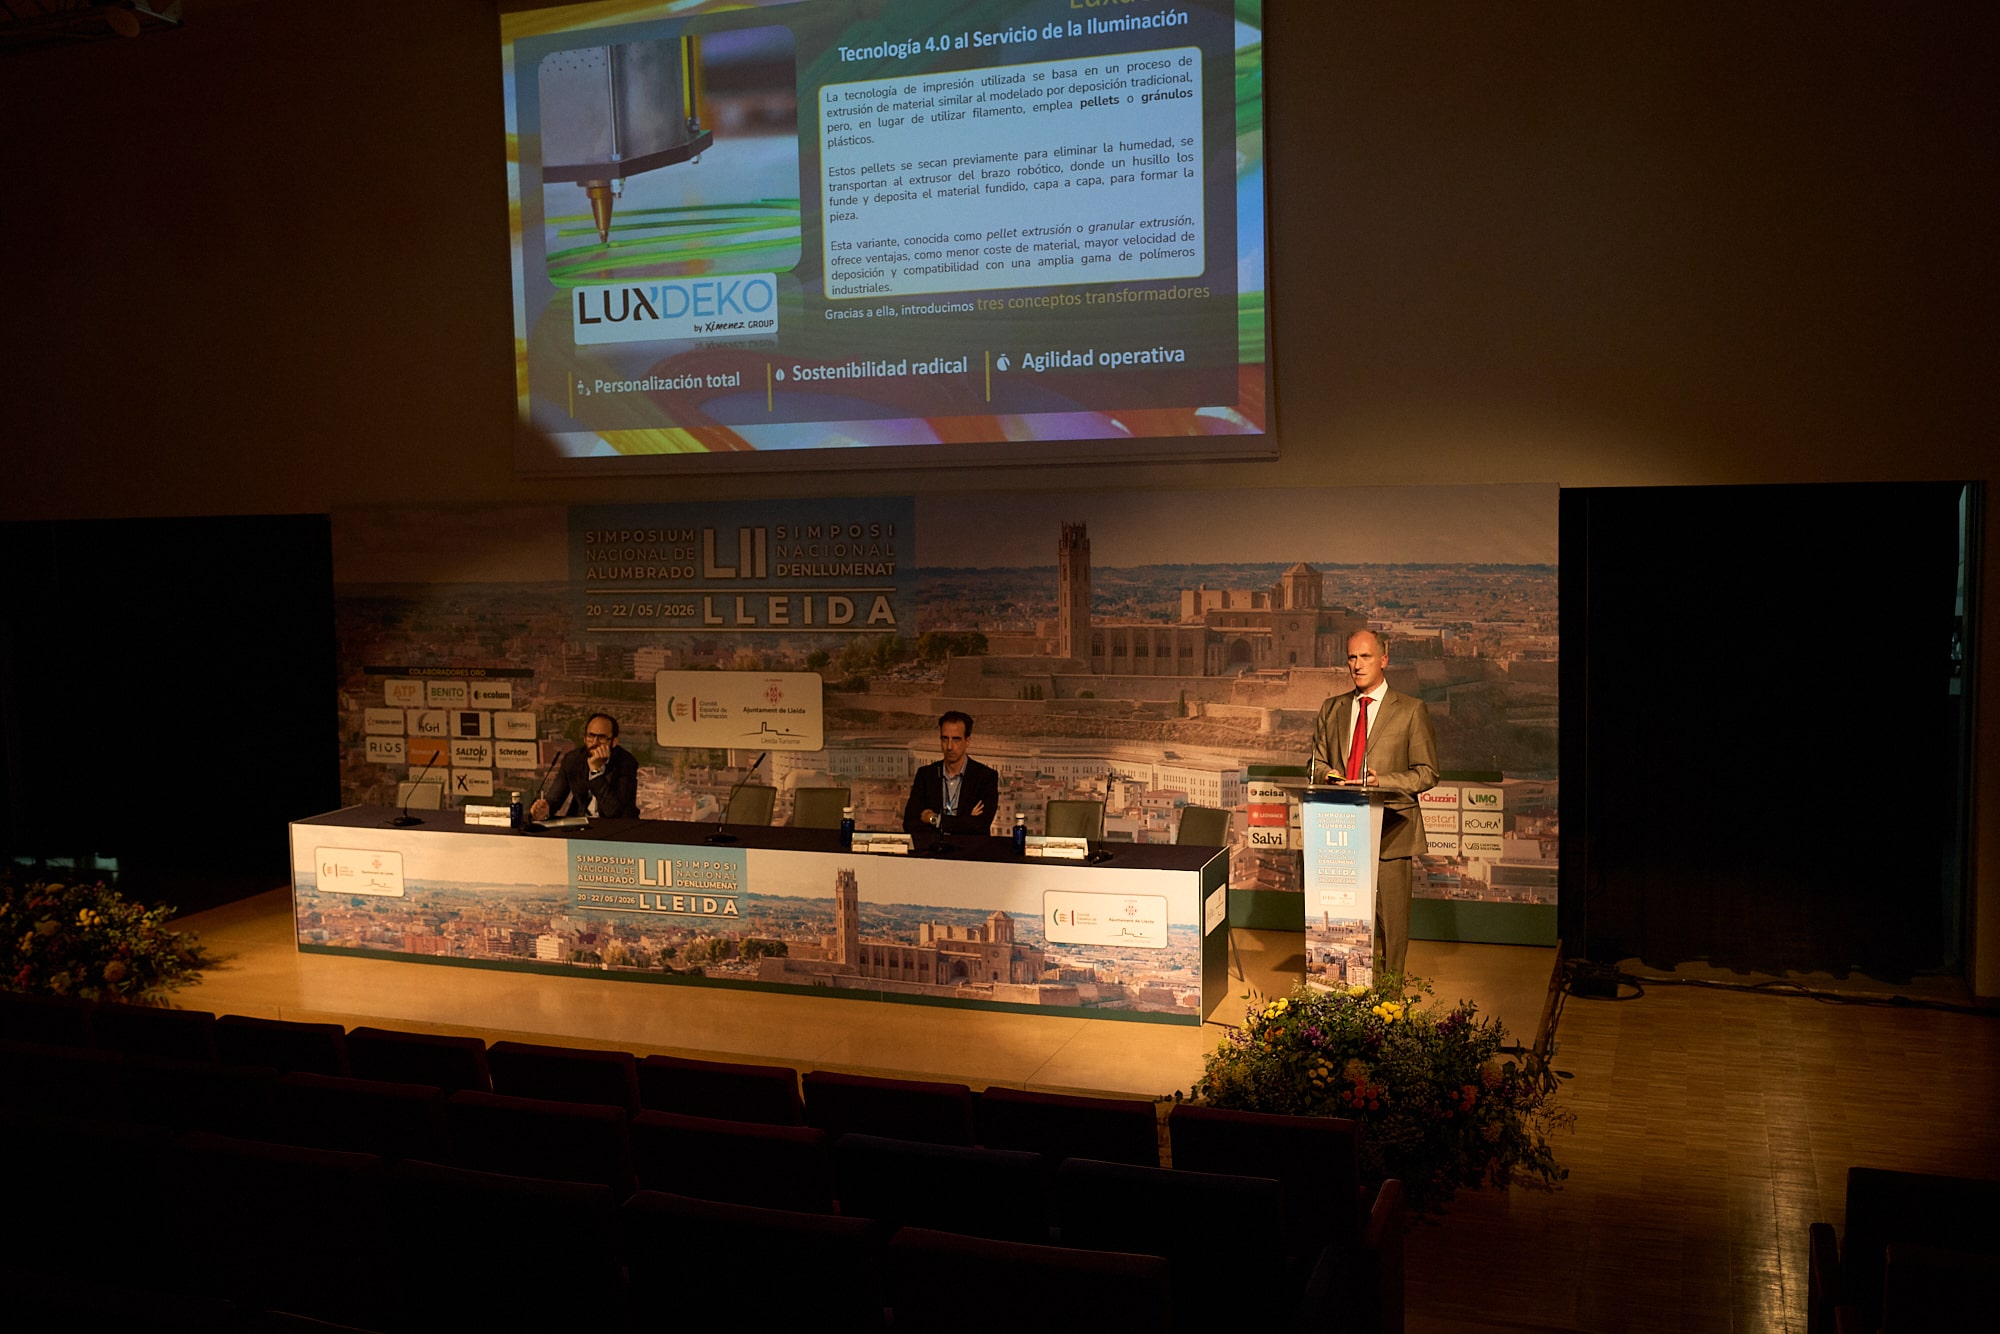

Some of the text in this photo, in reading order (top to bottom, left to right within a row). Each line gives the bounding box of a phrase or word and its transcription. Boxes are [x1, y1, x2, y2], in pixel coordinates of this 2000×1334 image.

[838, 9, 1188, 62] Tecnología 4.0 al Servicio de la Iluminación
[826, 55, 1192, 102] La tecnología de impresión utilizada se basa en un proceso de
[826, 71, 1192, 117] extrusión de material similar al modelado por deposición tradicional,
[827, 87, 1193, 134] pero, en lugar de utilizar filamento, emplea pellets o gránulos
[827, 133, 874, 149] plásticos.
[828, 136, 1193, 177] Estos pellets se secan previamente para eliminar la humedad, se
[830, 214, 1194, 251] Esta variante, conocida como pellet extrusión o granular extrusión,
[830, 230, 1195, 265] ofrece ventajas, como menor coste de material, mayor velocidad de
[831, 246, 1195, 282] deposición y compatibilidad con una amplia gama de polímeros
[831, 282, 892, 295] industriales.
[824, 285, 1210, 320] Gracias a ella, introducimos tres conceptos transformadores
[694, 319, 774, 333] by Ximenez GROUP
[1022, 346, 1185, 371] Agilidad operativa
[792, 356, 968, 382] Sostenibilidad radical
[595, 371, 740, 393] Personalización total
[585, 529, 694, 544] SIMPOSIUM
[776, 524, 893, 539] SIMPOSI
[586, 547, 695, 561] NACIONAL DE
[703, 527, 767, 578] LII
[776, 543, 895, 558] NACIONAL
[586, 566, 695, 580] ALUMBRADO
[776, 562, 896, 577] D'ENLLUMENAT
[586, 604, 695, 617] 20 22 05 2026
[704, 596, 896, 625] LLEIDA
[393, 685, 416, 697] ATP
[431, 687, 464, 697] BENITO
[483, 690, 510, 700] ecolum
[743, 706, 777, 714] Ajuntament
[455, 747, 488, 757] SALTOKI
[1259, 788, 1284, 797] acisa
[1420, 793, 1457, 803] iGuzzini
[1475, 794, 1497, 804] IMQ
[1422, 815, 1456, 823] estart
[1252, 832, 1283, 845] Salvi
[1326, 830, 1348, 847] LII
[576, 855, 635, 865] SIMPOSIUM
[676, 860, 737, 871] SIMPOSI
[577, 864, 635, 875] NACIONAL DE
[638, 858, 673, 887] LII
[677, 870, 737, 881] NACIONAL
[1318, 868, 1357, 876] LLEIDA
[577, 874, 635, 885] ALUMBRADO
[676, 879, 738, 891] D'ENLLUMENAT
[577, 893, 636, 905] 20 22 05 2026
[639, 893, 739, 915] LLEIDA
